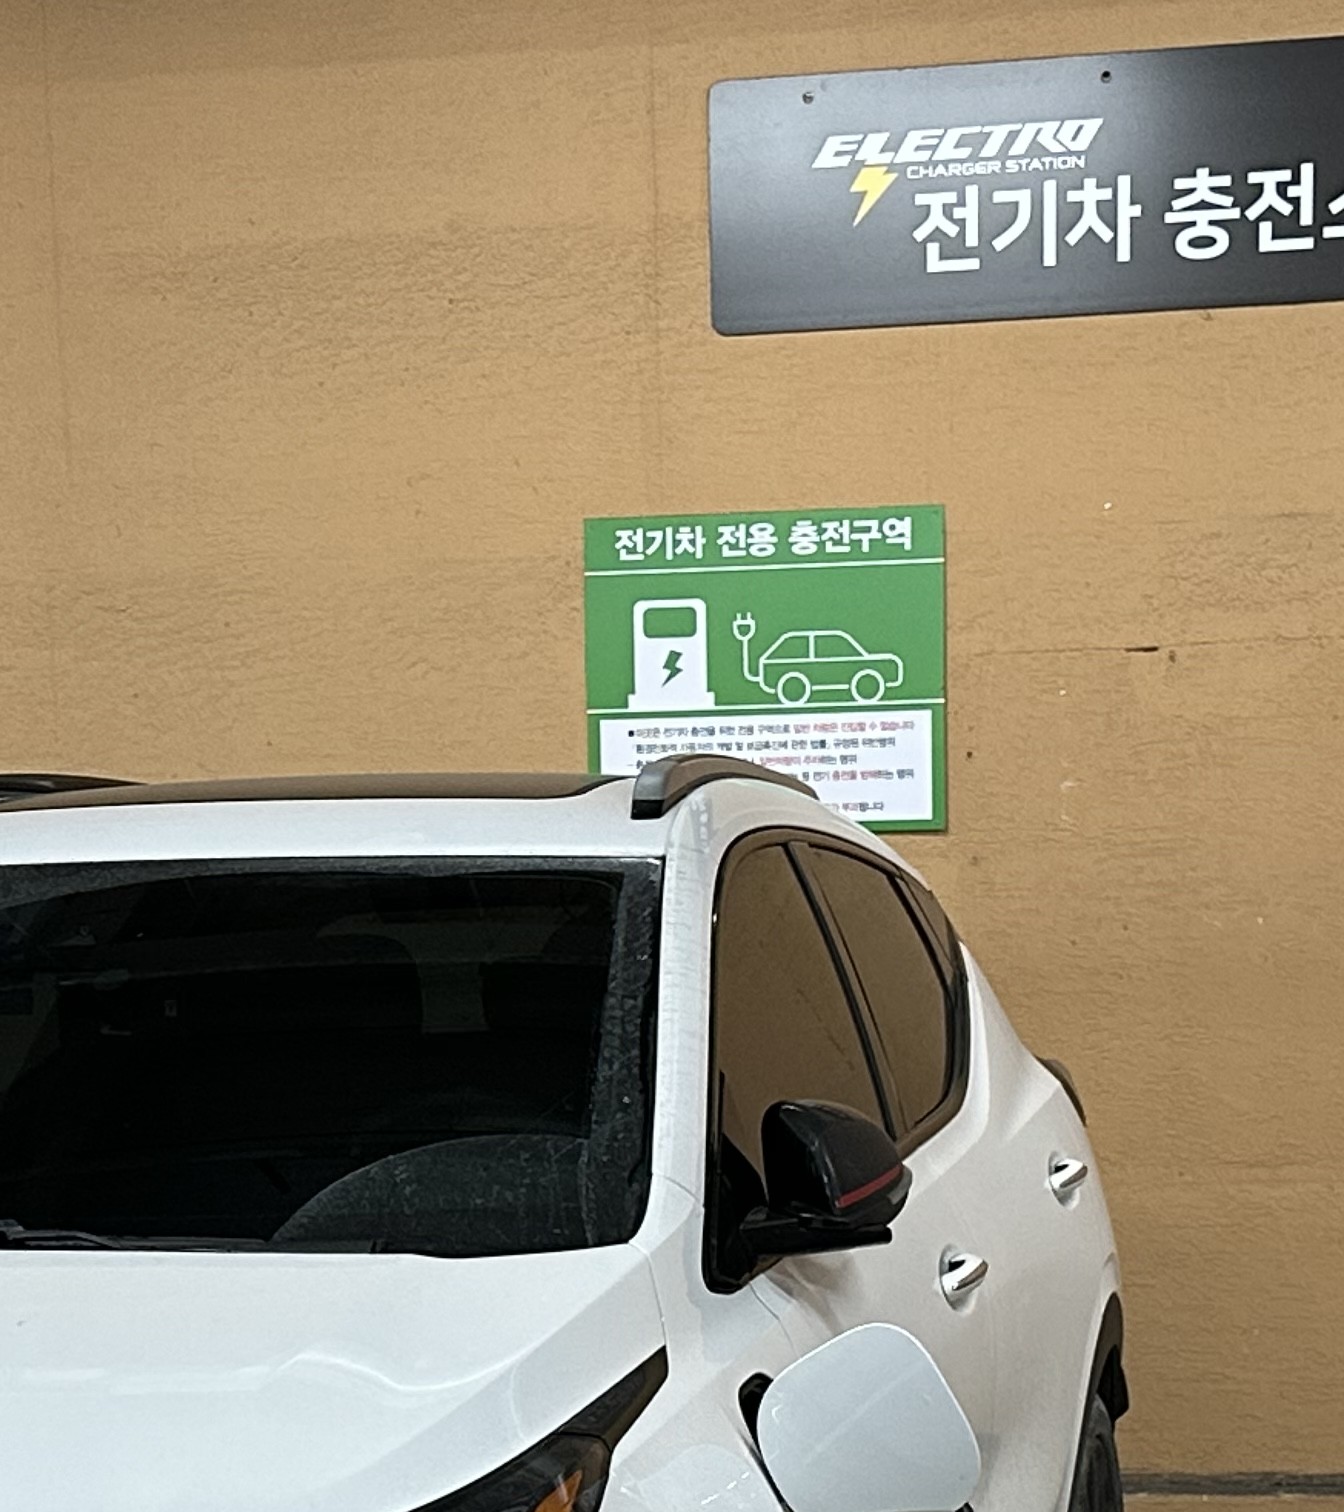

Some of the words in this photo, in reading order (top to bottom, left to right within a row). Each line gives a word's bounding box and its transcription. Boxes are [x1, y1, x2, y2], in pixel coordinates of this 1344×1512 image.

[810, 117, 1104, 169] ELECTRO
[906, 160, 1001, 179] CHARGER
[1005, 154, 1086, 173] STATION
[912, 174, 1142, 274] 전기차
[614, 525, 707, 561] 전기차
[716, 521, 779, 558] 전용
[788, 516, 914, 552] 충전구역
